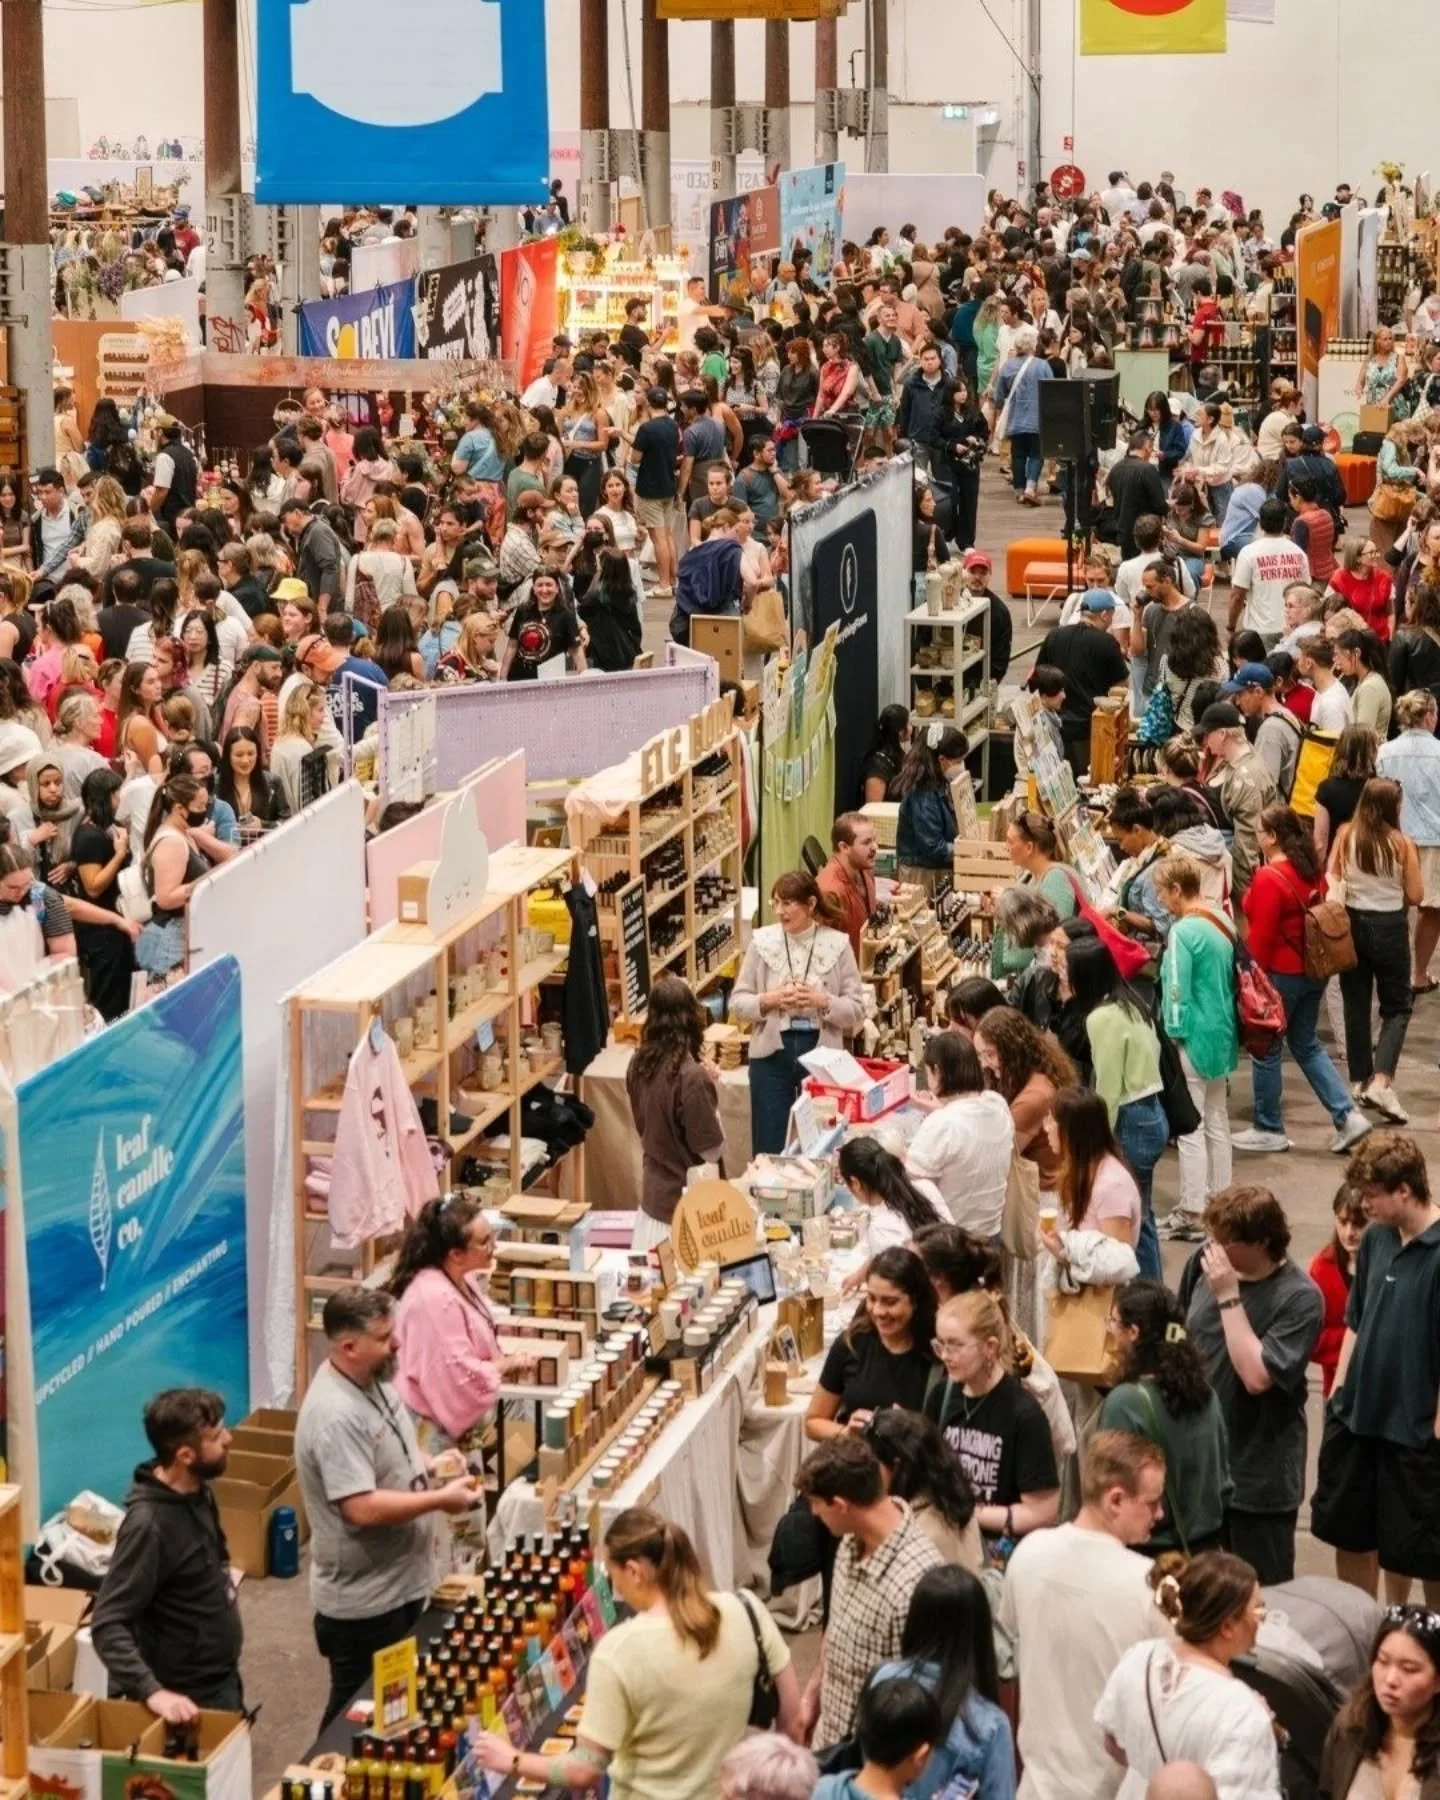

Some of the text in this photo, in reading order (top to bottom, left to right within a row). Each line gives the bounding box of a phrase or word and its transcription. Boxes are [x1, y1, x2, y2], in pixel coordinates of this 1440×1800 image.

[116, 1113, 152, 1172] leaf
[117, 1144, 174, 1210] candle
[117, 1216, 143, 1250] co.
[696, 1201, 726, 1229] leaf
[702, 1216, 751, 1249] candle
[95, 1322, 125, 1356] HAND
[125, 1291, 164, 1333] POURED
[172, 1238, 229, 1294] ENCHANTING
